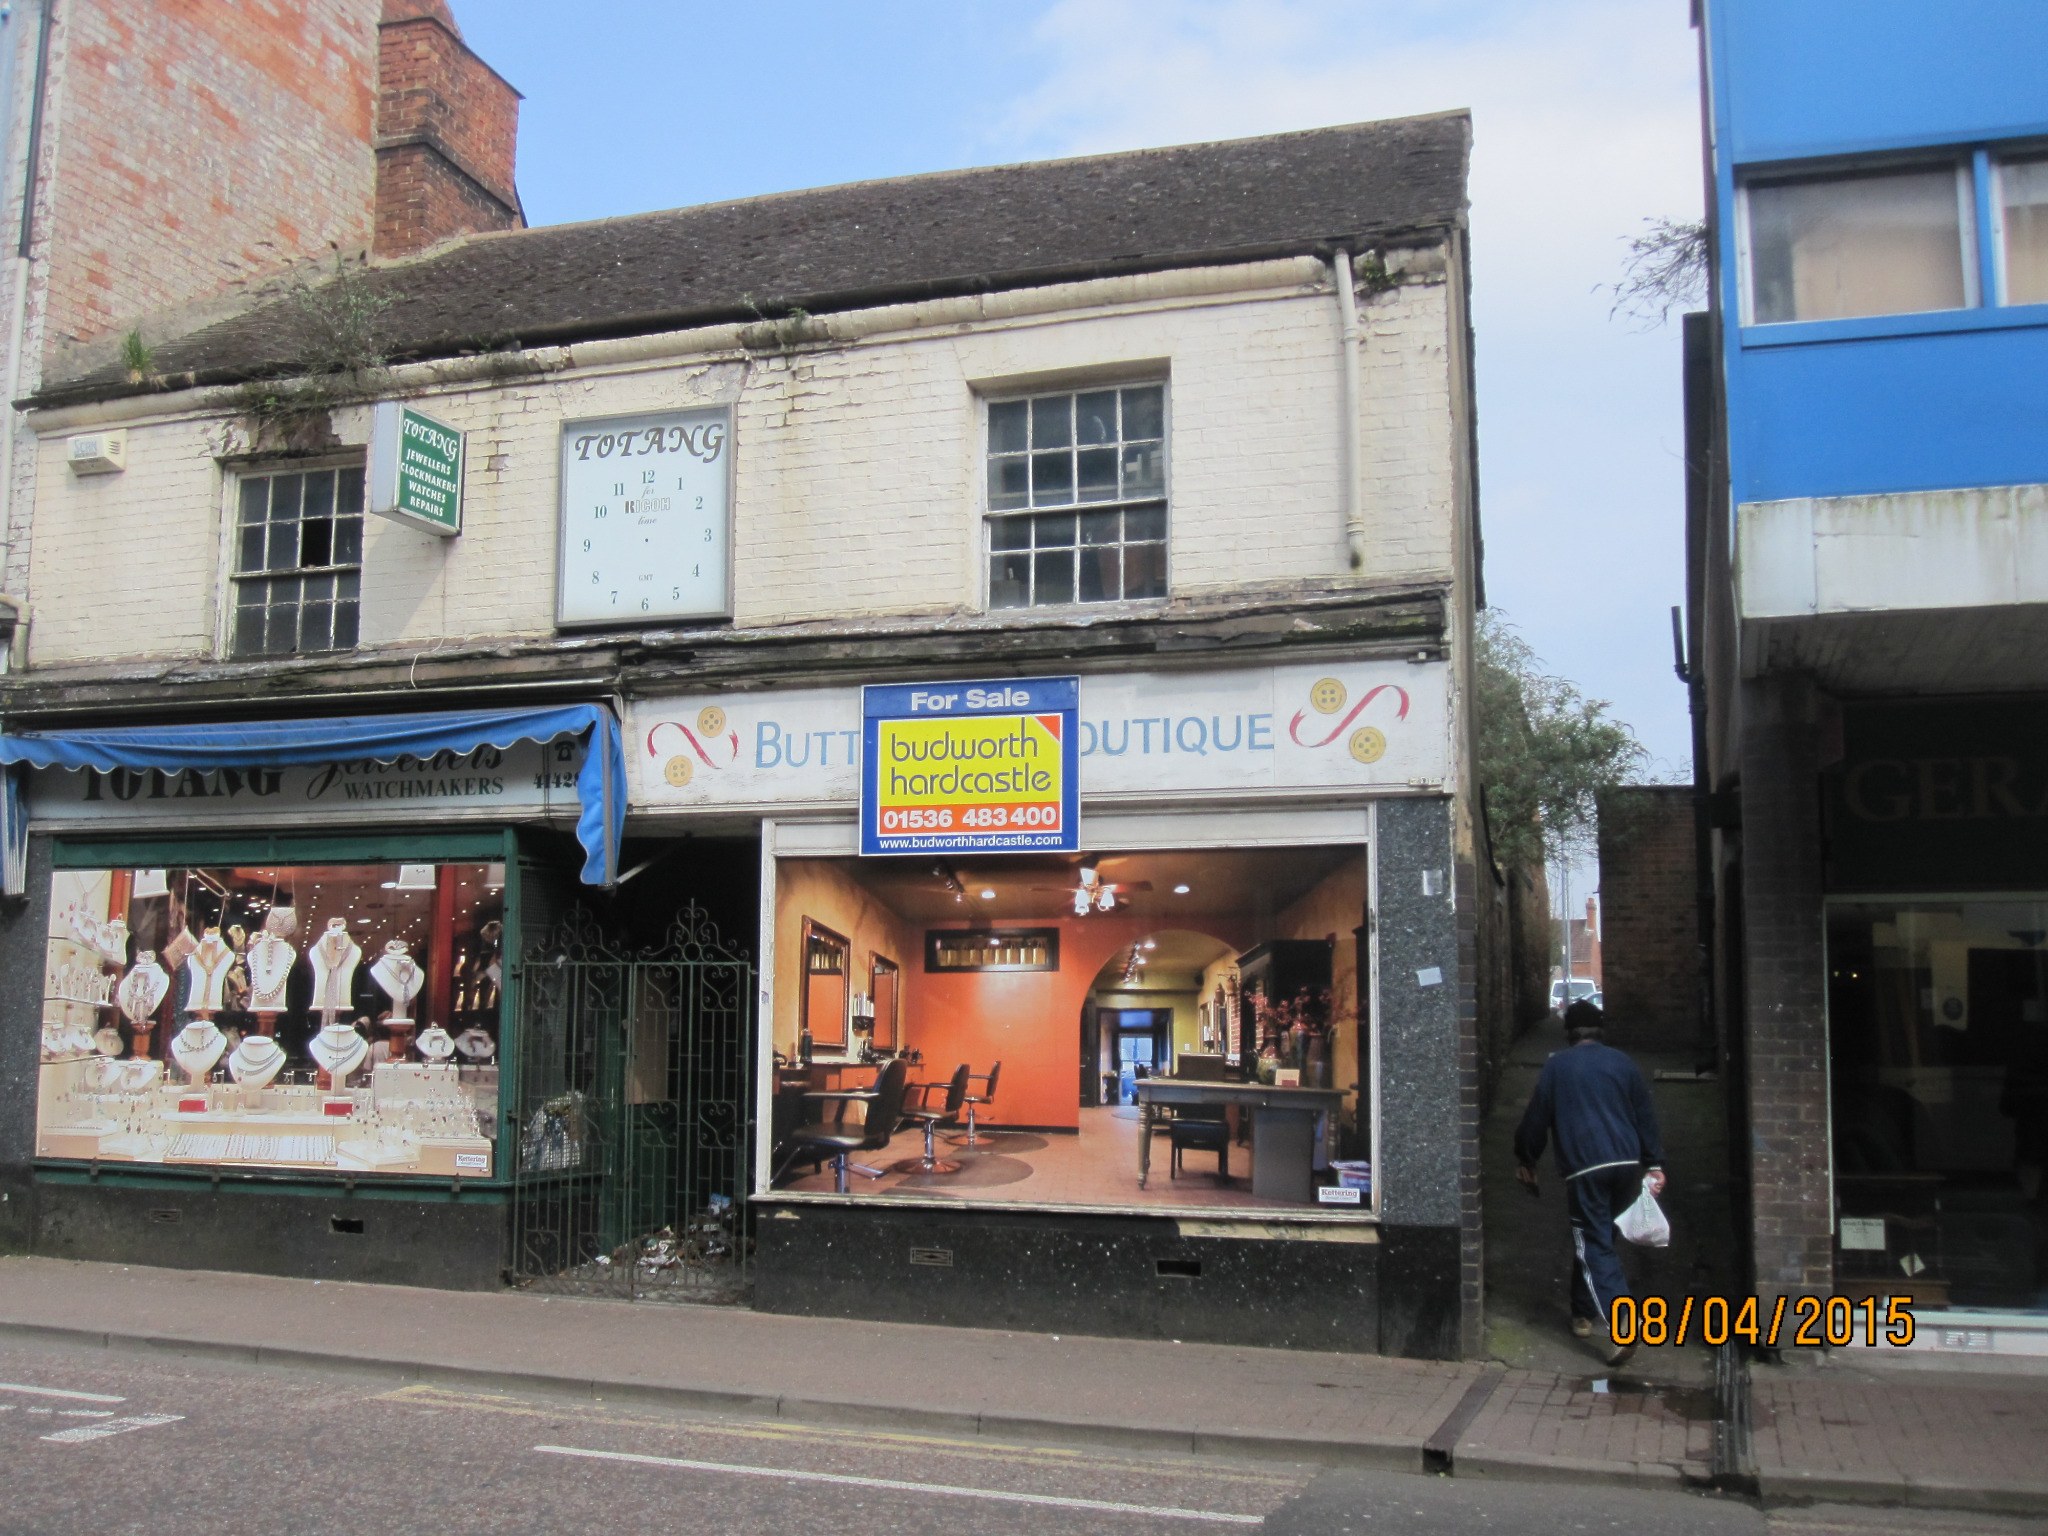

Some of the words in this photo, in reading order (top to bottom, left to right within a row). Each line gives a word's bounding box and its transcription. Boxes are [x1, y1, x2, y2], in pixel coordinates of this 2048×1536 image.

[404, 419, 458, 462] TOTANG
[575, 423, 726, 464] TOTANG
[406, 448, 451, 475] JEWELLERS
[401, 463, 457, 493] CLOCKMAKERS
[641, 469, 655, 484] 12
[677, 477, 683, 491] 1
[409, 480, 446, 503] WATCHES
[613, 483, 624, 496] 11
[410, 496, 443, 517] REPAIRS
[624, 497, 671, 514] RICOH
[695, 496, 703, 510] 2
[594, 505, 607, 519] 10
[704, 528, 712, 542] 3
[583, 539, 591, 553] 9
[592, 571, 600, 584] 8
[692, 563, 700, 577] 4
[610, 590, 618, 604] 7
[672, 586, 680, 600] 5
[641, 598, 649, 612] 6
[911, 692, 958, 711] For
[966, 688, 1030, 709] Sale
[756, 721, 860, 769] BUTT
[1081, 714, 1275, 757] OUTIQUE
[891, 717, 1038, 762] budworth
[891, 763, 1052, 796] hardcastle
[344, 777, 504, 800] WATCHMAKERS
[1843, 756, 2048, 824] GER
[884, 809, 953, 829] 01536
[880, 835, 1063, 849] www.budworthhardcastle.com
[1321, 1188, 1357, 1198] Kettering
